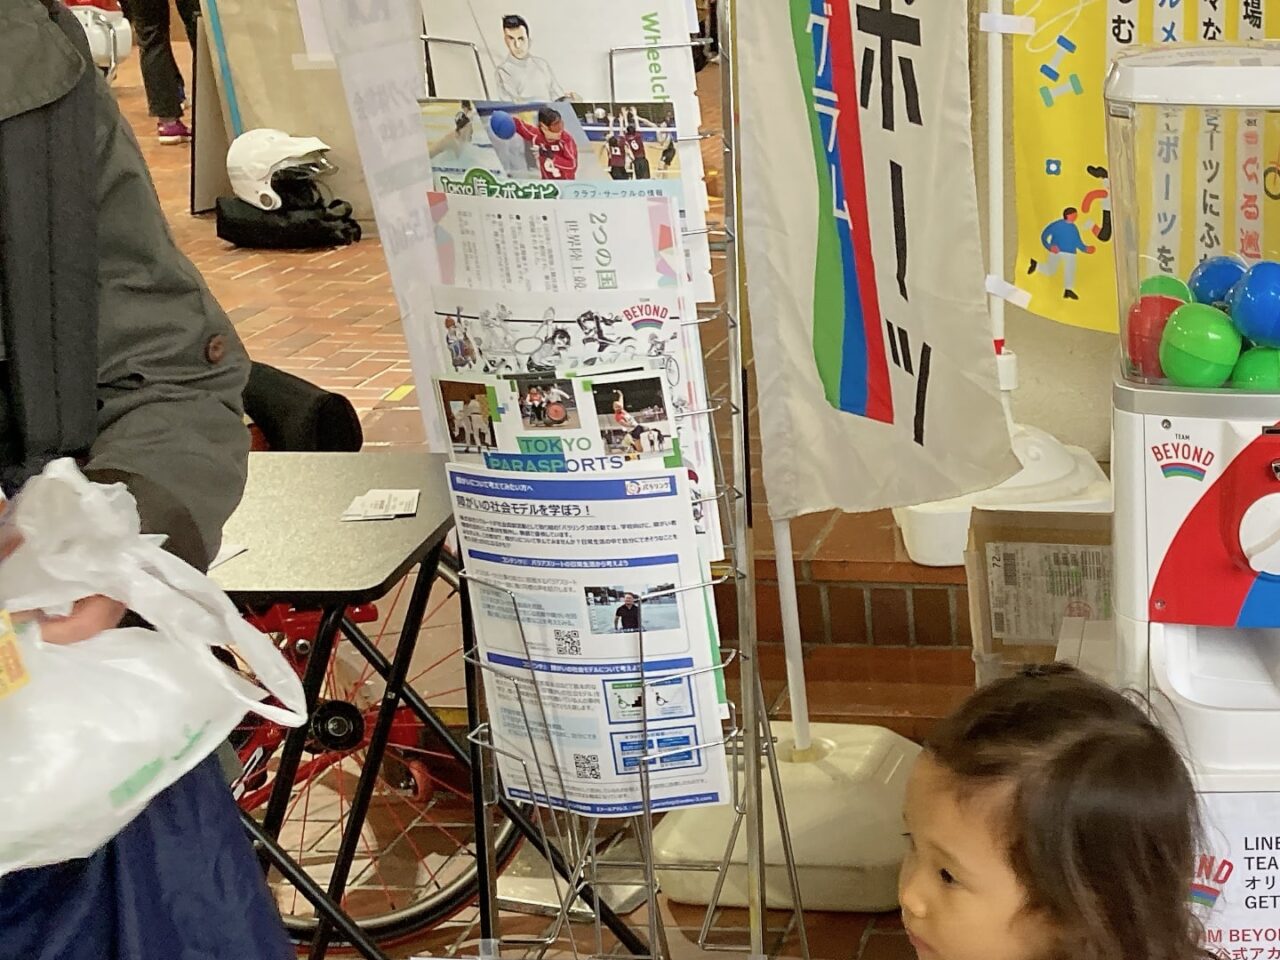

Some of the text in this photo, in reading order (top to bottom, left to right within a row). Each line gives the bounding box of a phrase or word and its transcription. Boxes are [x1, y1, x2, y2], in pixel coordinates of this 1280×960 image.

[1158, 0, 1181, 43] メ
[1202, 0, 1222, 41] な
[622, 304, 669, 320] BEYOND
[521, 437, 592, 453] TOKYO
[1175, 433, 1190, 441] TEAM
[1151, 442, 1215, 467] BEYOND
[489, 456, 623, 472] PARASPORTS
